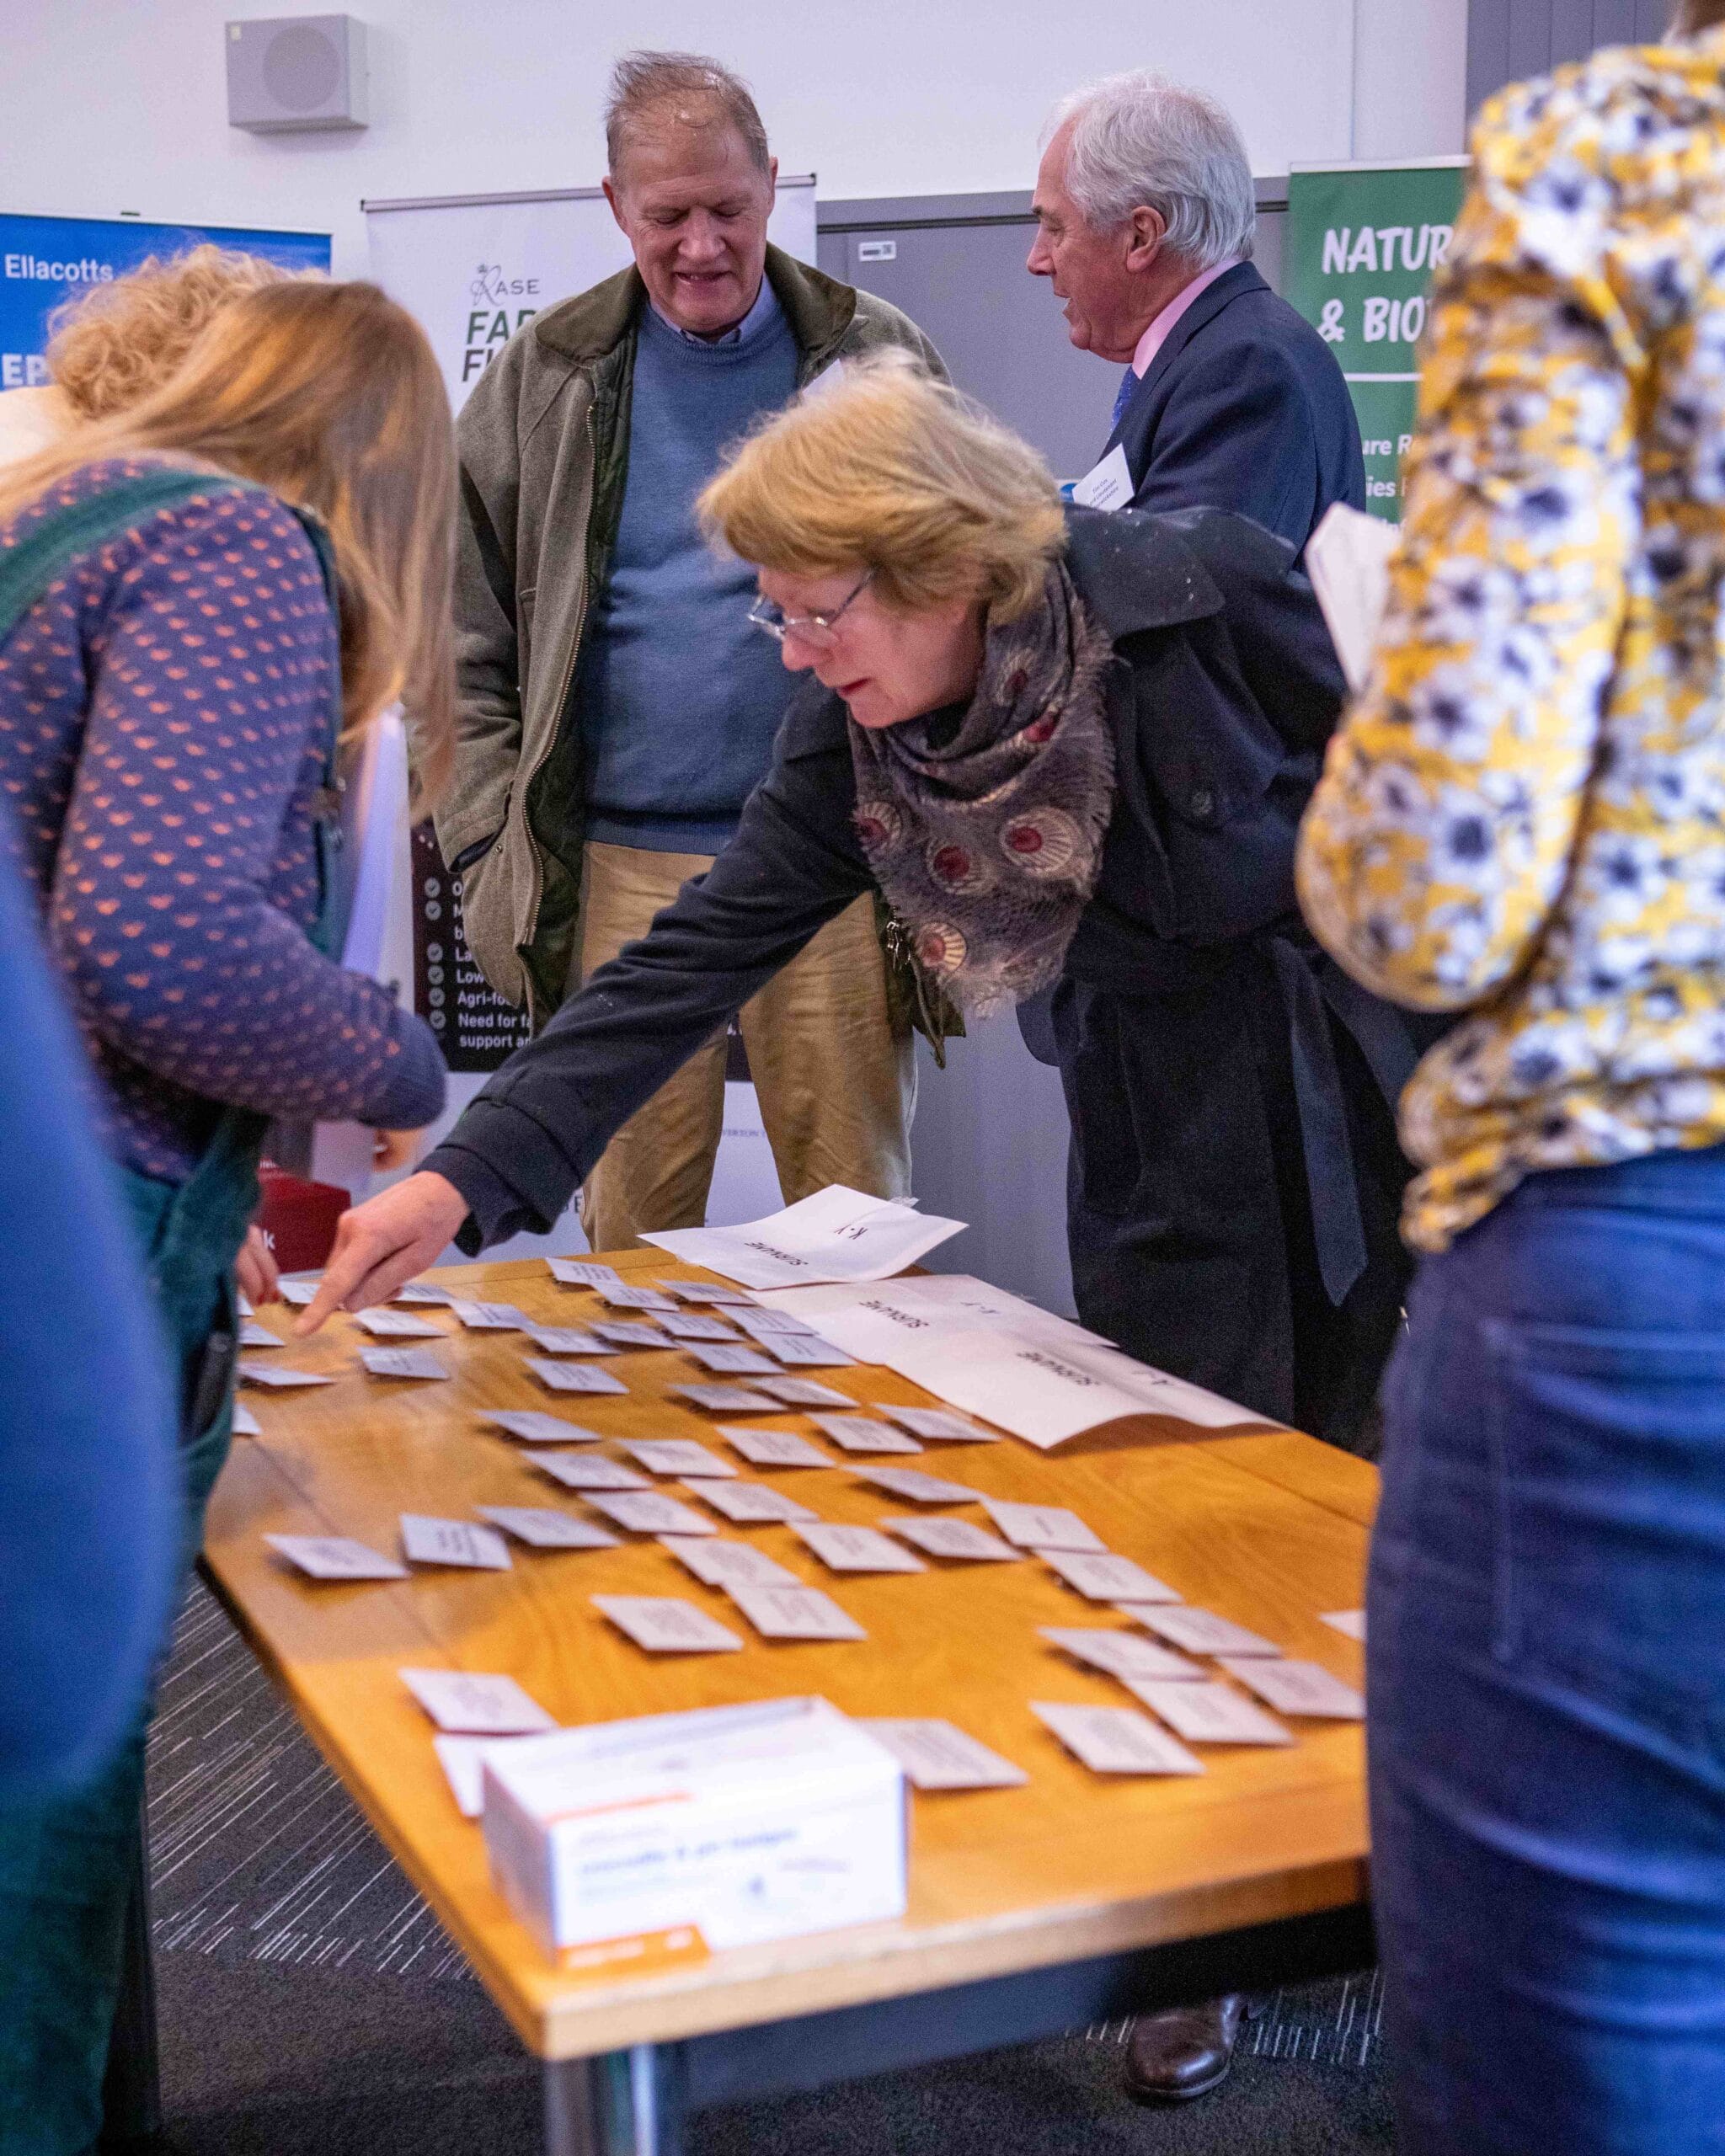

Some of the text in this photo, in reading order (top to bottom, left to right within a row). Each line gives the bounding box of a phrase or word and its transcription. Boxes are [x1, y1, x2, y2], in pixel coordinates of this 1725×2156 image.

[1322, 223, 1454, 275] NATUR
[5, 253, 114, 283] Ellacotts
[1316, 296, 1430, 343] & BIO
[1365, 475, 1397, 498] ies
[454, 926, 463, 941] b
[455, 946, 473, 963] La
[457, 990, 511, 1009] Agri-fo
[458, 1013, 494, 1028] Need
[498, 1013, 518, 1028] for
[459, 1034, 513, 1051] support
[263, 1229, 275, 1251] k
